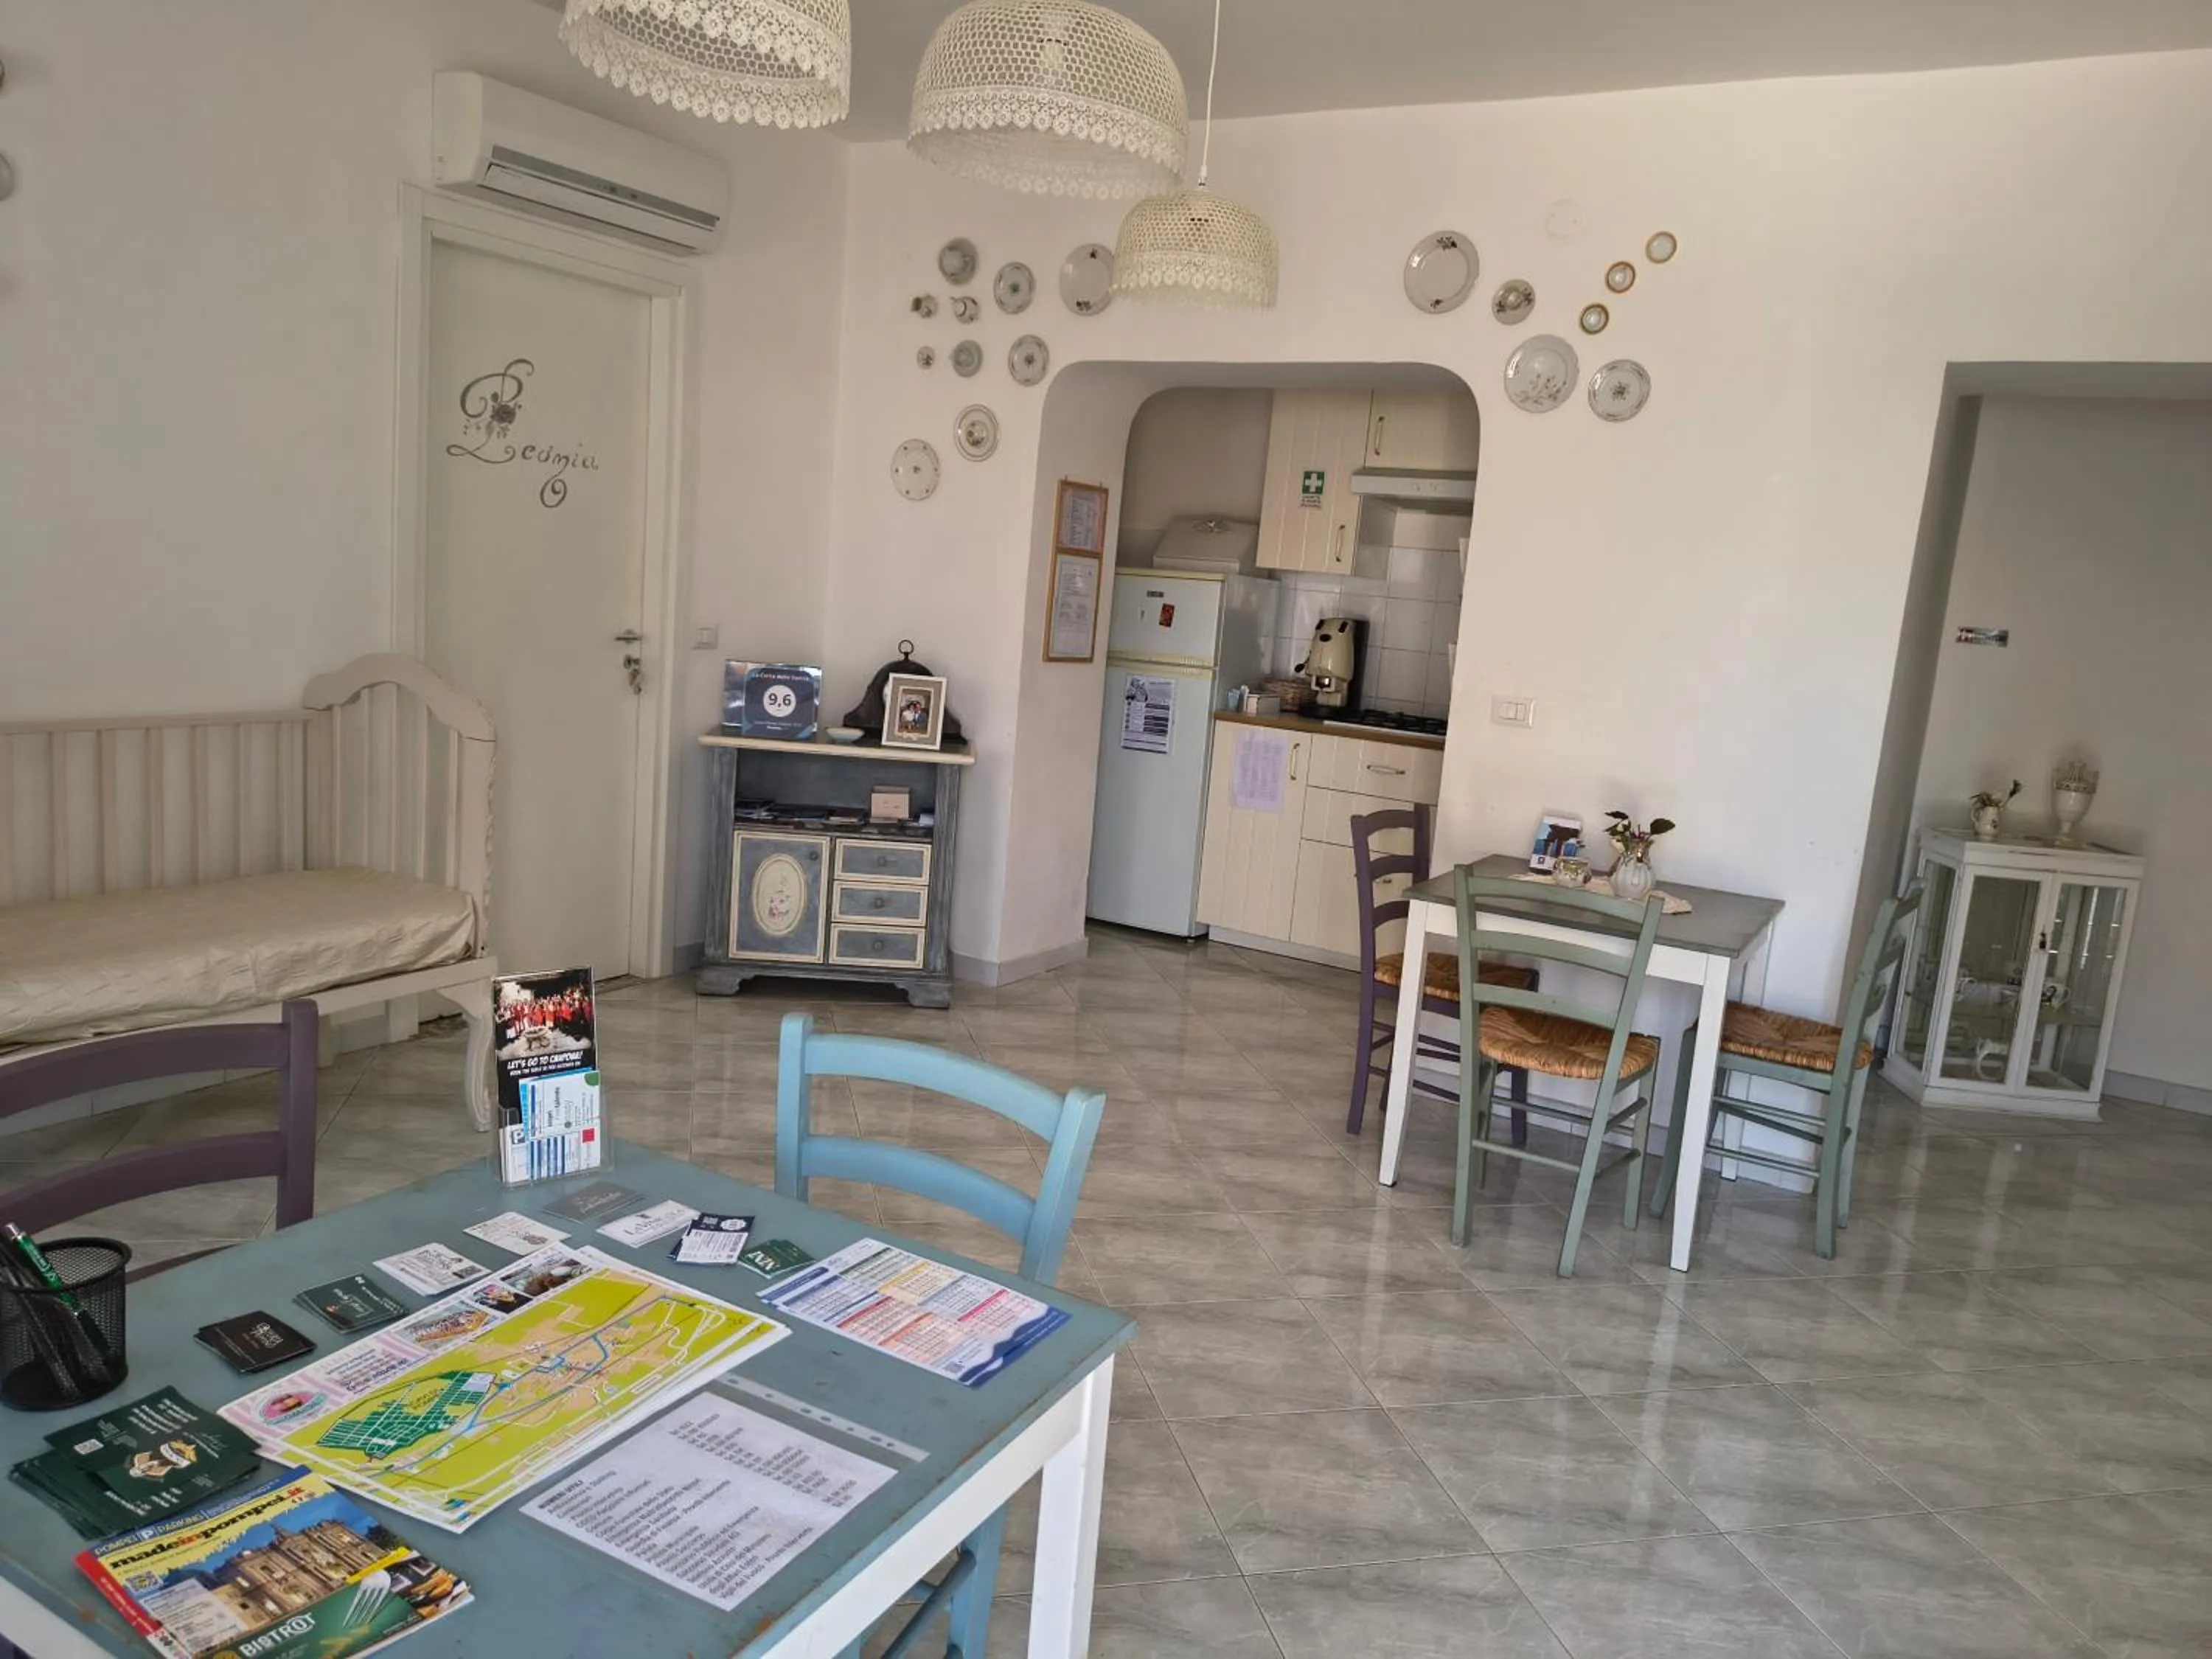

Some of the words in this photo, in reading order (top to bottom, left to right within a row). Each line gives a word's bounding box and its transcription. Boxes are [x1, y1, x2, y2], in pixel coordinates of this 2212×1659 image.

[768, 692, 791, 708] 9,6
[507, 1057, 526, 1071] LET'S
[527, 1055, 539, 1067] GO
[539, 1055, 549, 1065] TO
[110, 1486, 305, 1571] madeinpompei.it
[157, 1514, 204, 1534] PARKING
[238, 1611, 317, 1658] BISTROT
